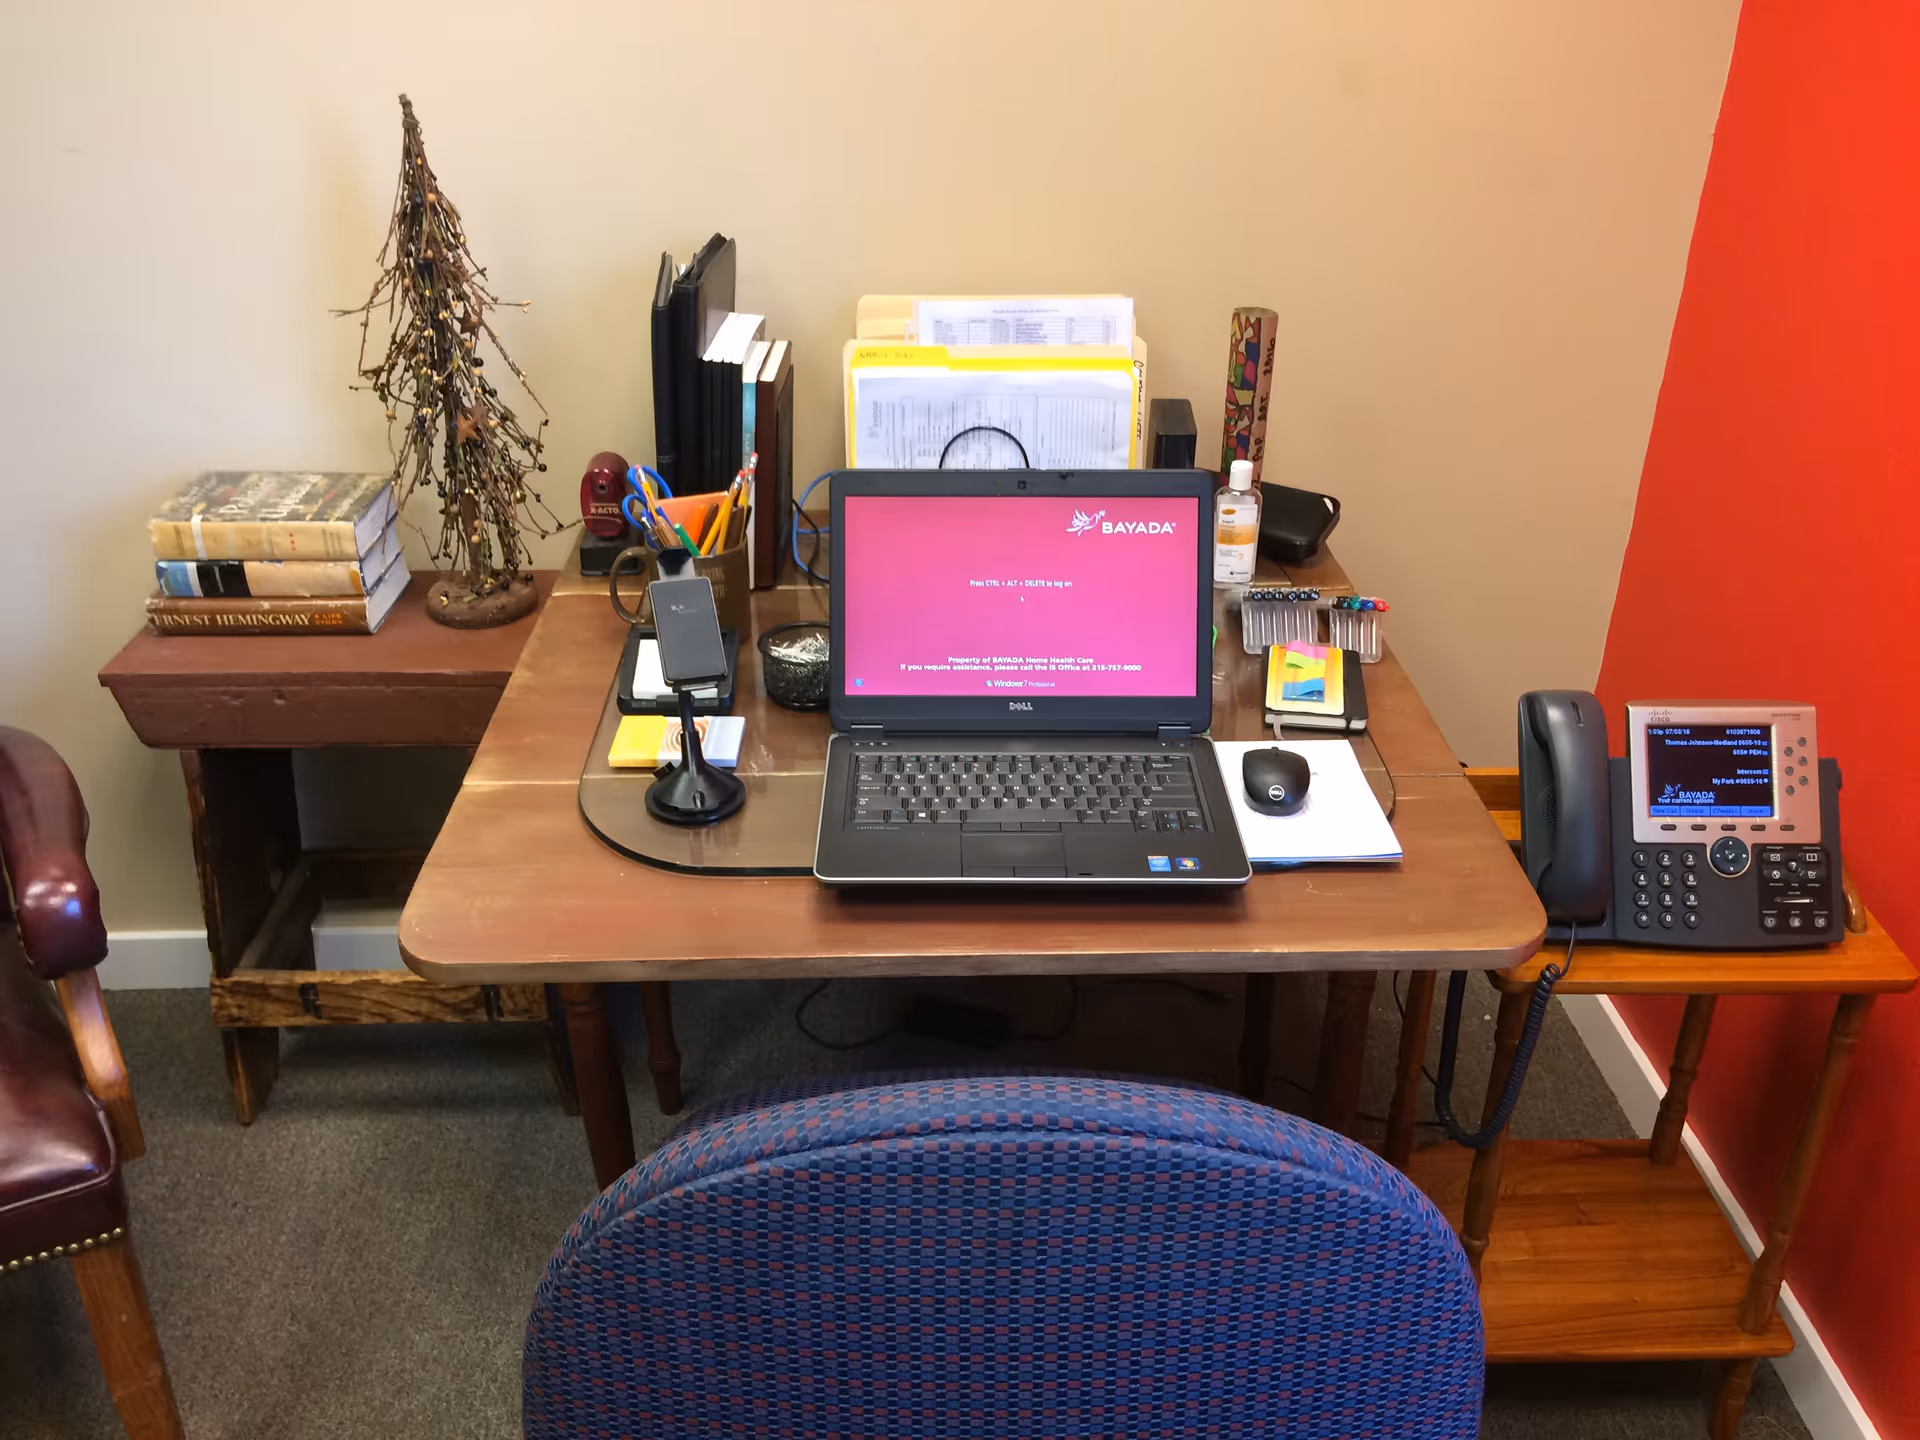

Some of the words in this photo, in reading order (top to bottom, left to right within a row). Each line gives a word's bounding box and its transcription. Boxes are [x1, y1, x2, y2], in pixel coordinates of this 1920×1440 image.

[1102, 521, 1174, 534] BAYADA
[969, 579, 985, 587] Press
[985, 579, 1000, 587] CTRL
[1006, 579, 1018, 587] ALT
[1024, 579, 1046, 587] DELETE
[1053, 580, 1063, 588] log
[153, 614, 211, 626] ERNEST
[215, 613, 312, 626] HEMINGWAY
[1008, 702, 1033, 710] DELL
[1712, 777, 1721, 785] My
[1679, 791, 1715, 799] BAYADA
[1693, 797, 1714, 805] options
